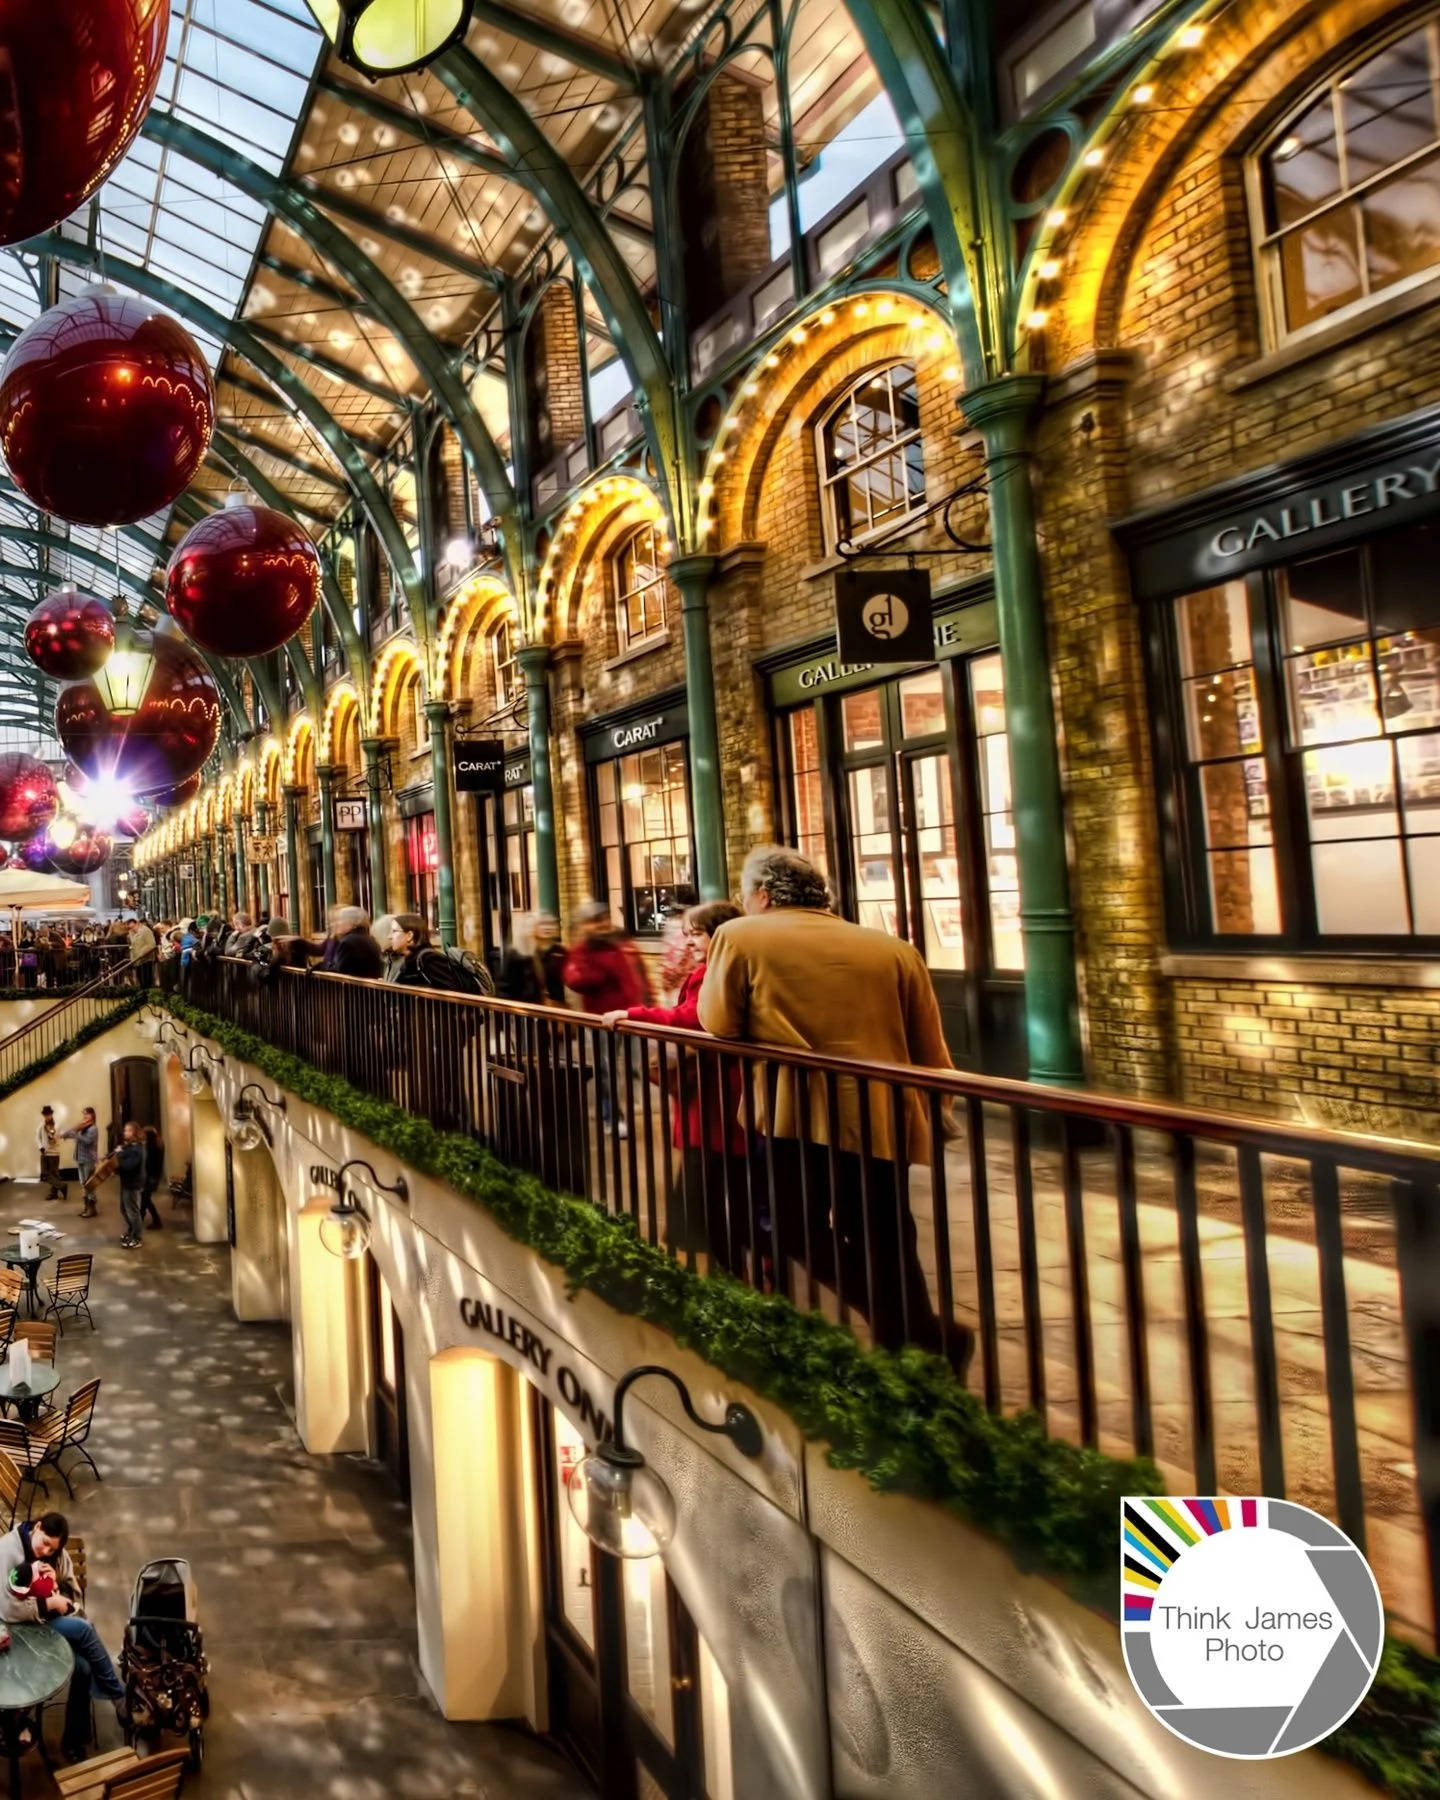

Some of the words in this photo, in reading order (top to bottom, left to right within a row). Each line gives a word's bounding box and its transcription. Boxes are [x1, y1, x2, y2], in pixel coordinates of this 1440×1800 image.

[1210, 457, 1440, 557] GALLERY
[613, 721, 659, 748] CARAT
[458, 760, 498, 772] CARAT
[460, 1297, 553, 1376] GALLERY
